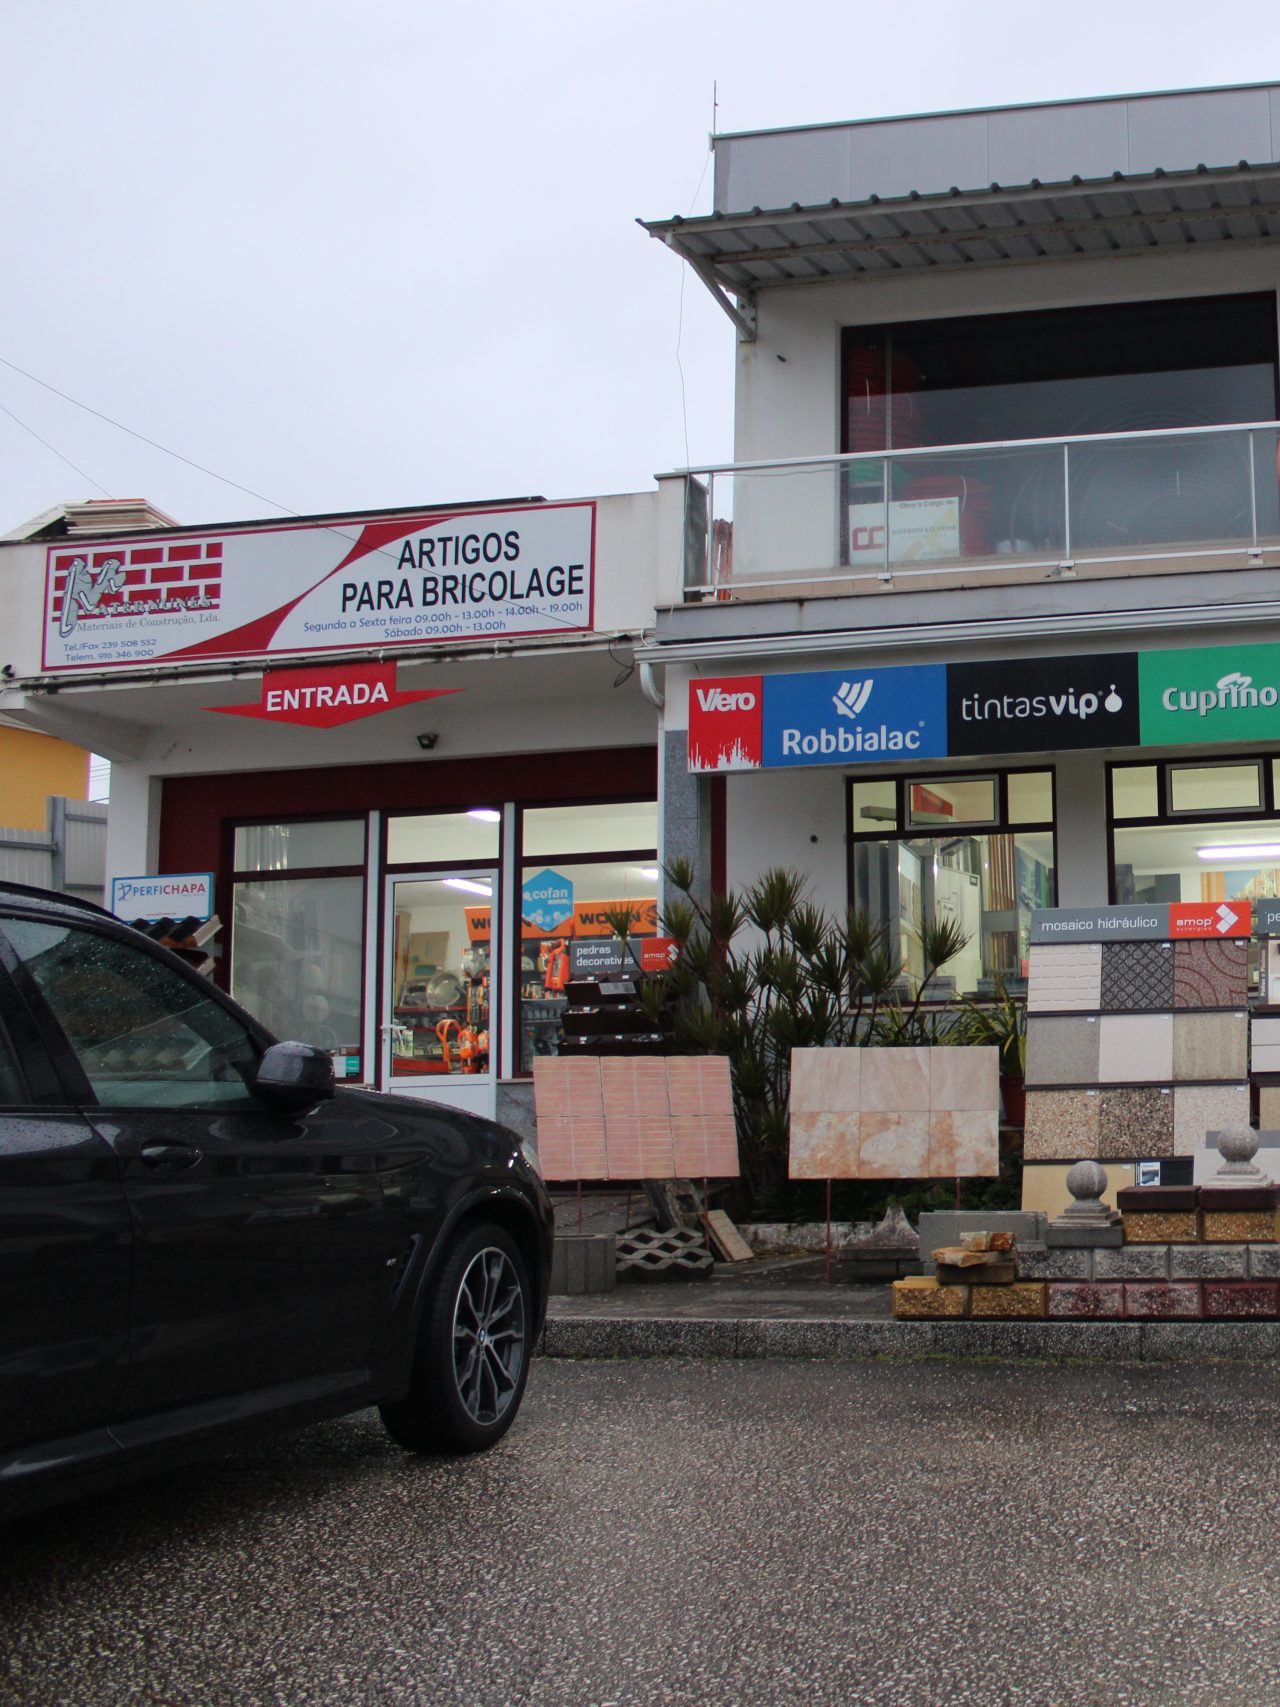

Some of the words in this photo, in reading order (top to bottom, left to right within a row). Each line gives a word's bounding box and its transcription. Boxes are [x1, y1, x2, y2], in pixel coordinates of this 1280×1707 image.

[397, 530, 520, 570] ARTIGOS
[341, 578, 414, 613] PARA
[422, 564, 584, 607] BRICOLAGE
[76, 620, 123, 632] Materiais
[126, 618, 138, 628] de
[140, 614, 197, 628] Construção,
[200, 613, 221, 624] Lda.
[304, 620, 347, 632] Segunda
[359, 618, 387, 628] Sexta
[389, 615, 412, 625] feira
[414, 612, 452, 624] 09.00h
[462, 608, 495, 620] 13.00h
[506, 604, 539, 616] 14.00h
[550, 602, 583, 613] 19.00h
[384, 627, 423, 638] Sábado
[426, 623, 463, 635] 09.00h
[473, 620, 506, 632] 13.00h
[102, 640, 118, 650] 239
[120, 640, 138, 648] 508
[140, 638, 157, 647] 552
[66, 652, 96, 662] Telem.
[98, 652, 112, 660] 916
[115, 650, 132, 658] 346
[135, 649, 154, 657] 900
[266, 682, 390, 712] ENTRADA
[696, 687, 756, 712] Viero
[962, 687, 1098, 720] tintasvip
[782, 725, 922, 756] Robbialac
[132, 883, 206, 896] PERFICHAPA
[532, 887, 568, 899] cofan
[579, 912, 641, 924] WON
[1041, 918, 1094, 932] mosaico
[1098, 917, 1158, 930] hidráulico
[1176, 918, 1212, 928] amop
[576, 945, 611, 958] pedras
